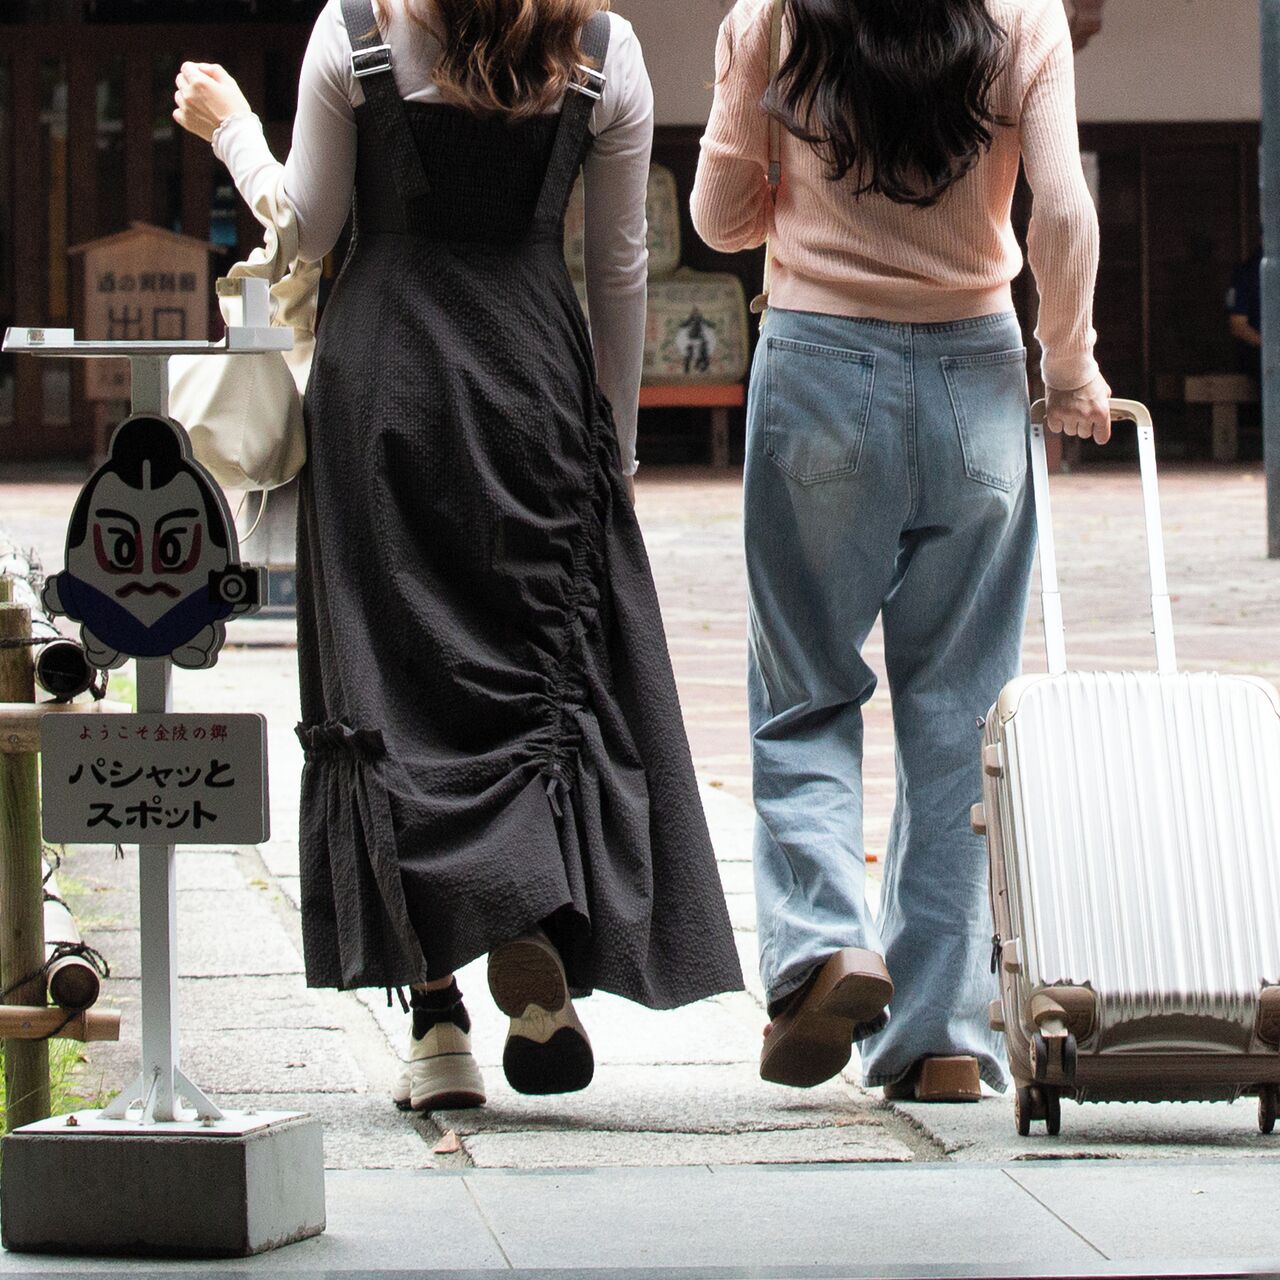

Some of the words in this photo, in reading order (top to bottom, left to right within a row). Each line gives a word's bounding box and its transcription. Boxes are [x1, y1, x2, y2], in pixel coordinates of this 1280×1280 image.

[107, 305, 187, 340] 出口
[79, 723, 228, 743] ようこそ金陵の郷
[68, 757, 235, 788] パシャッと
[86, 795, 218, 830] スポット
